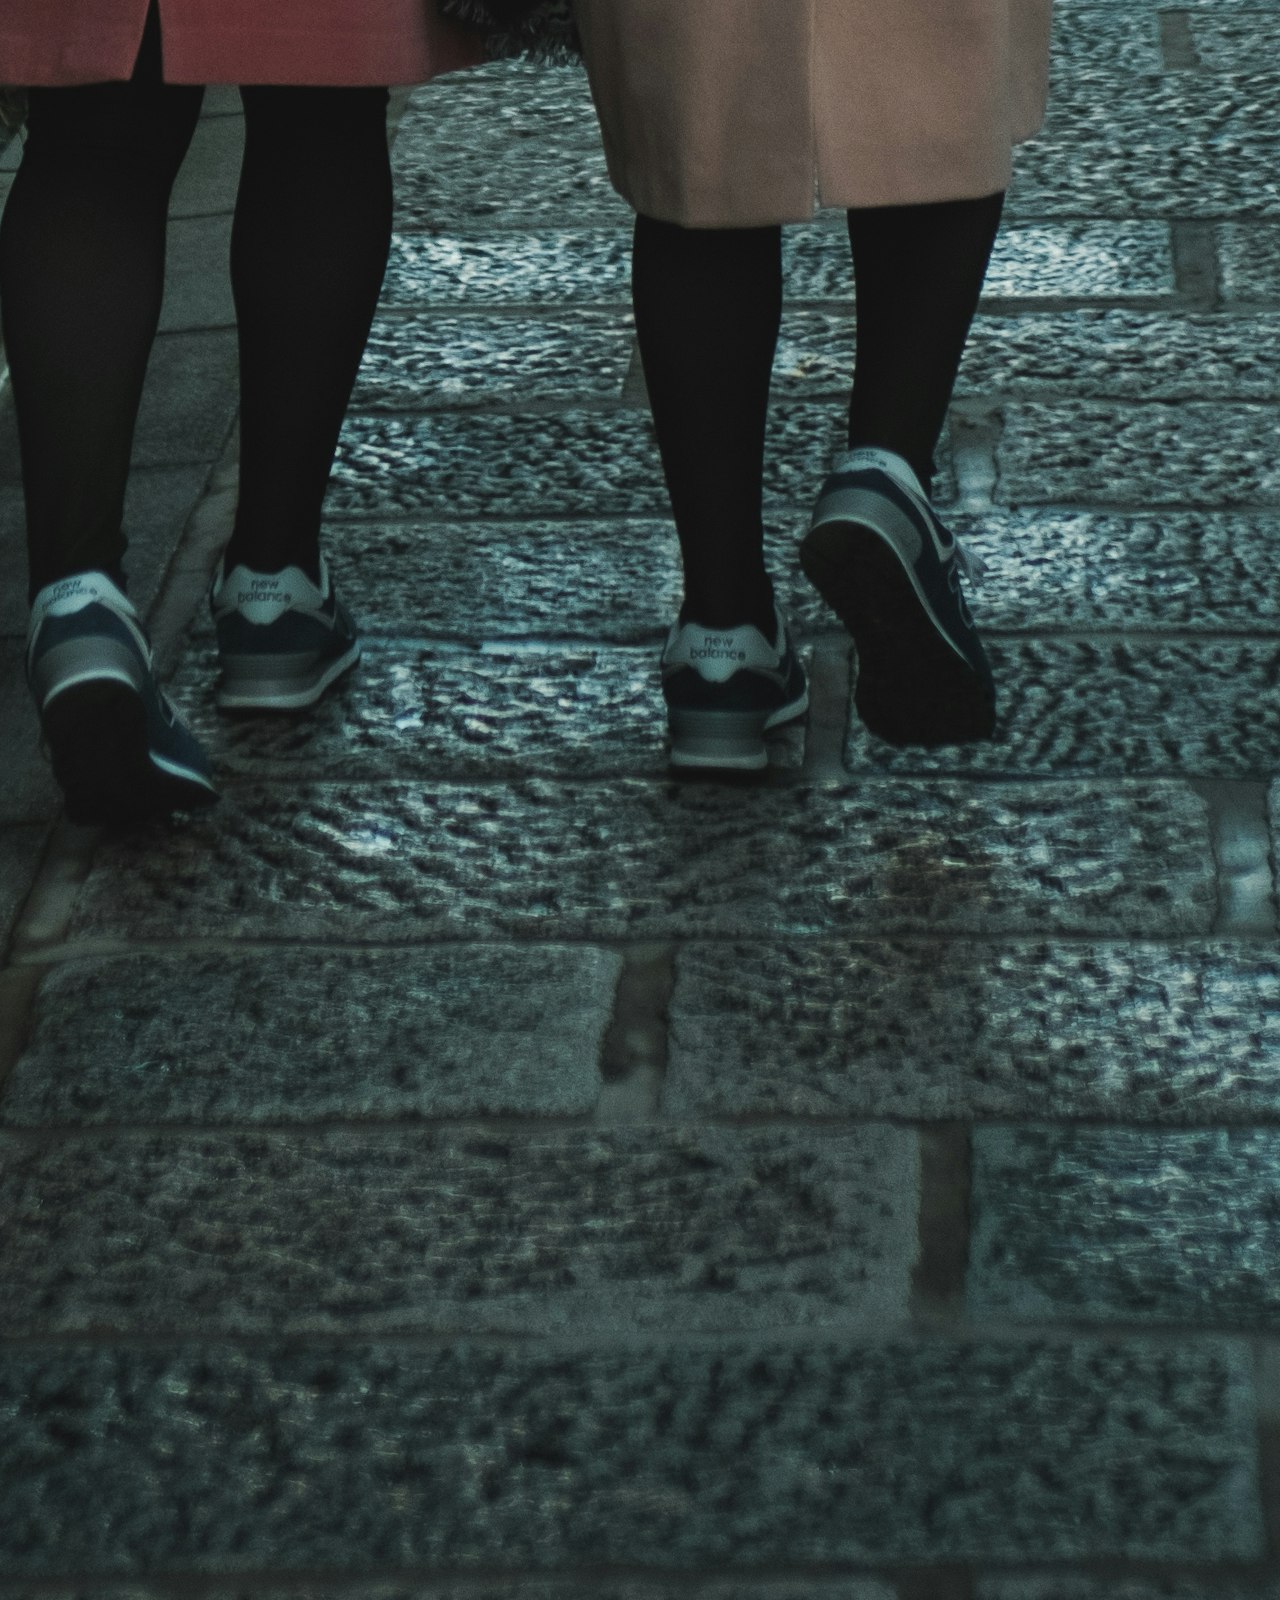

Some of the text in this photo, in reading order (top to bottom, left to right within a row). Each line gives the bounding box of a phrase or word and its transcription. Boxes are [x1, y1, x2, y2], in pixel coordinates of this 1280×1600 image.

[250, 579, 280, 590] new
[237, 591, 293, 604] balance
[704, 636, 734, 648] new
[689, 647, 747, 661] balance
